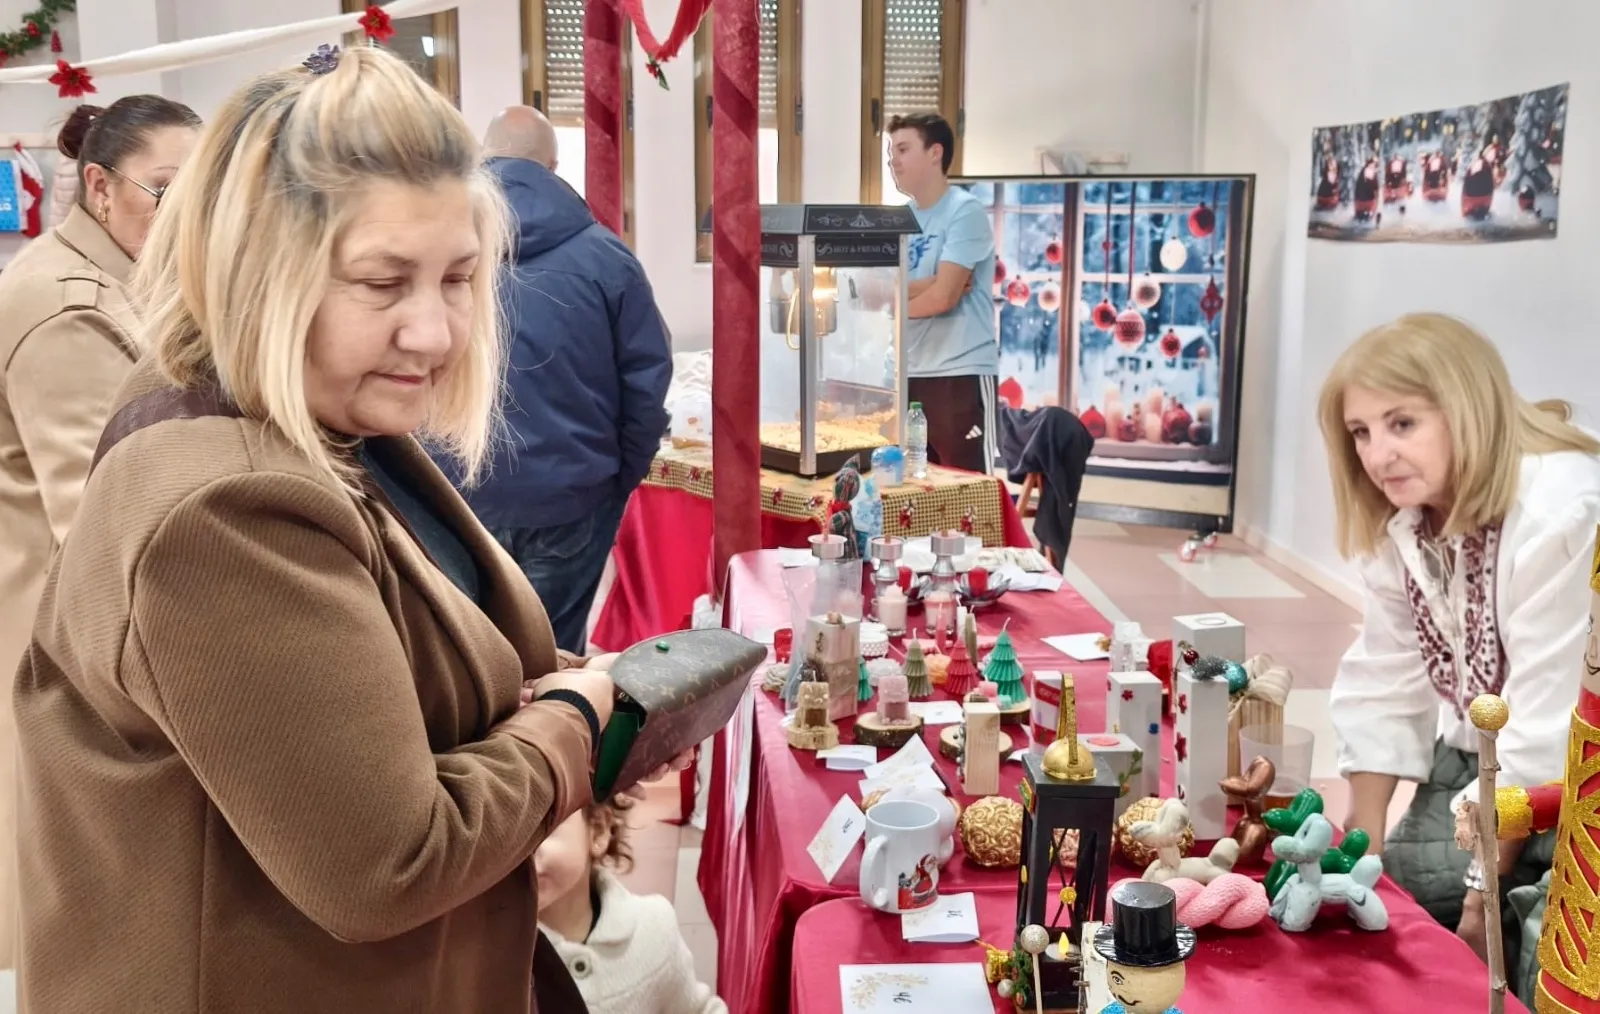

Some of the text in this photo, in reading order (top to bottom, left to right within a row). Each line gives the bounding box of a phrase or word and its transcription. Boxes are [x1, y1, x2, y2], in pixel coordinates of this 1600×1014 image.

[833, 245, 881, 253] HOT & FRESH
